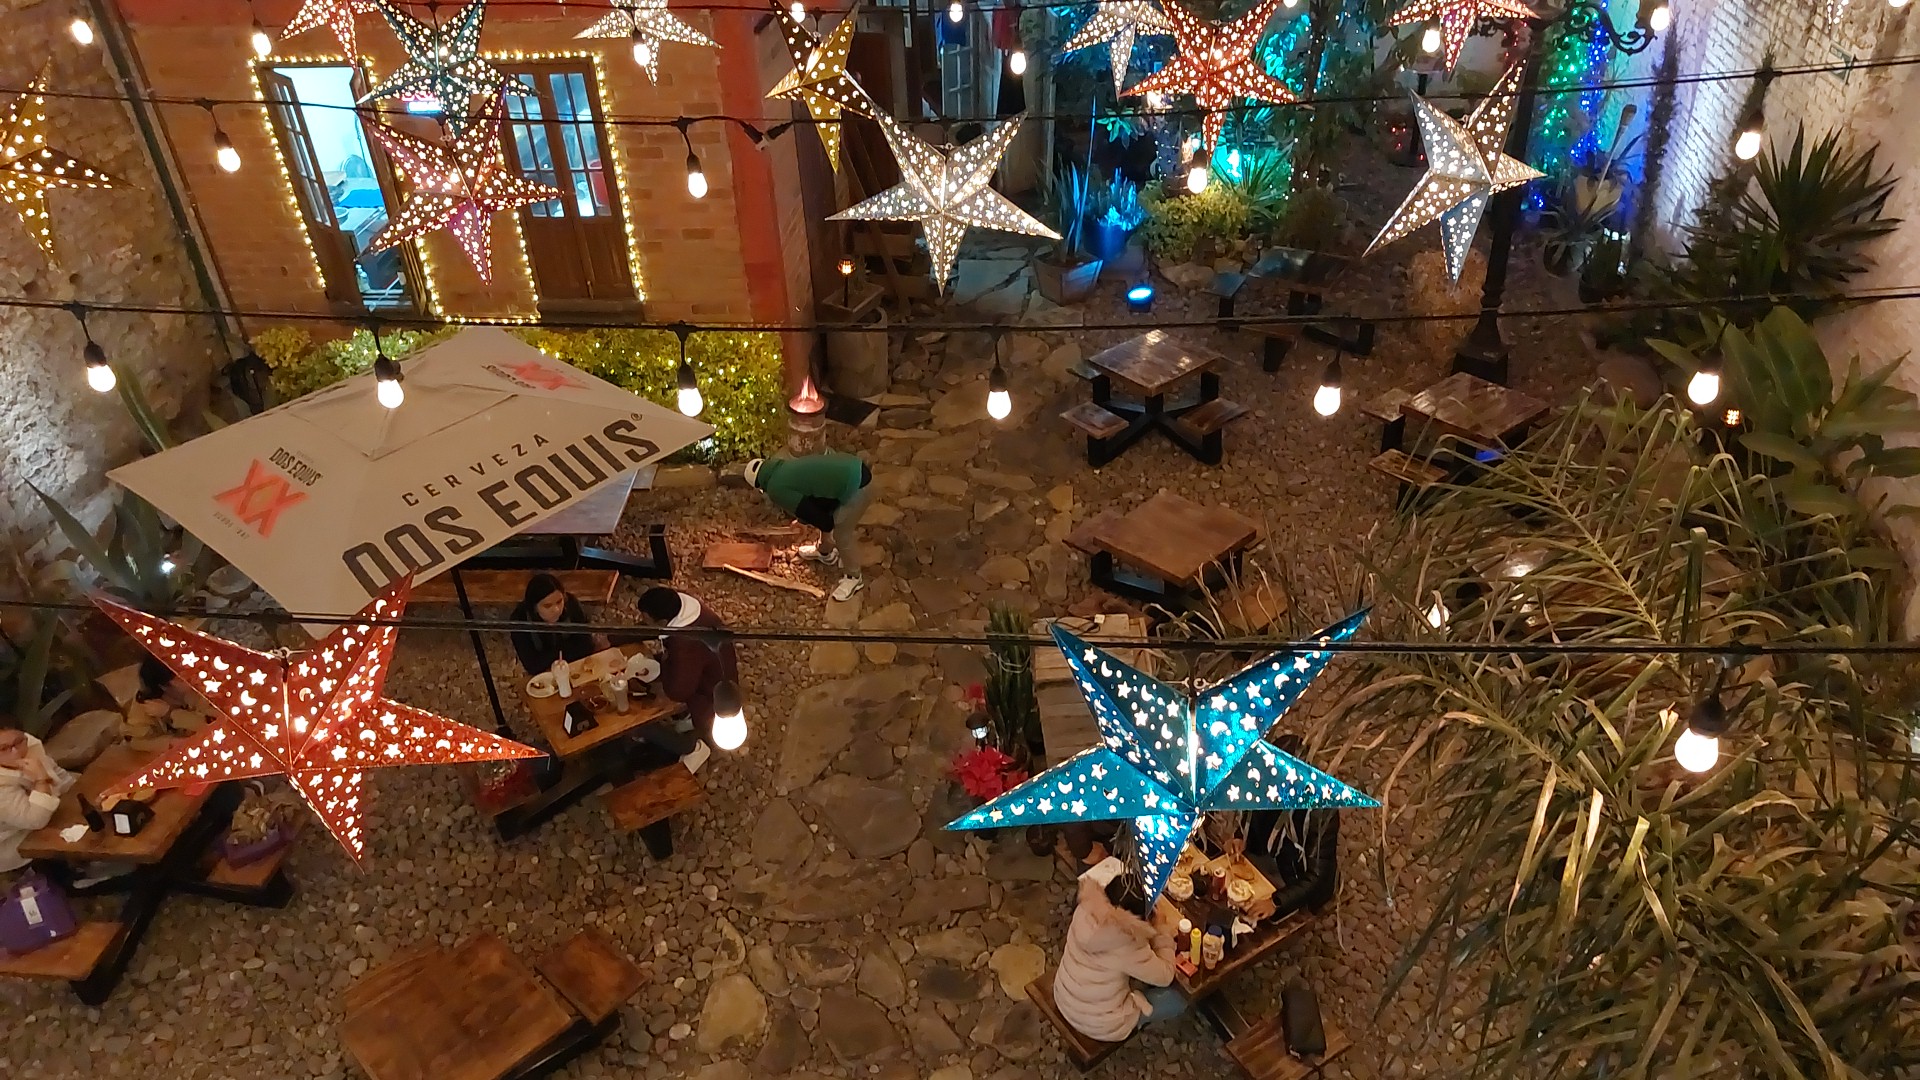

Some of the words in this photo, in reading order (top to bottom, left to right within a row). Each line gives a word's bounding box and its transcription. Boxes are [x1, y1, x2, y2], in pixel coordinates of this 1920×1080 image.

[269, 447, 296, 470] DOS
[287, 459, 323, 487] EQUIS
[402, 434, 549, 507] CERVEZA
[342, 505, 485, 599] DOS
